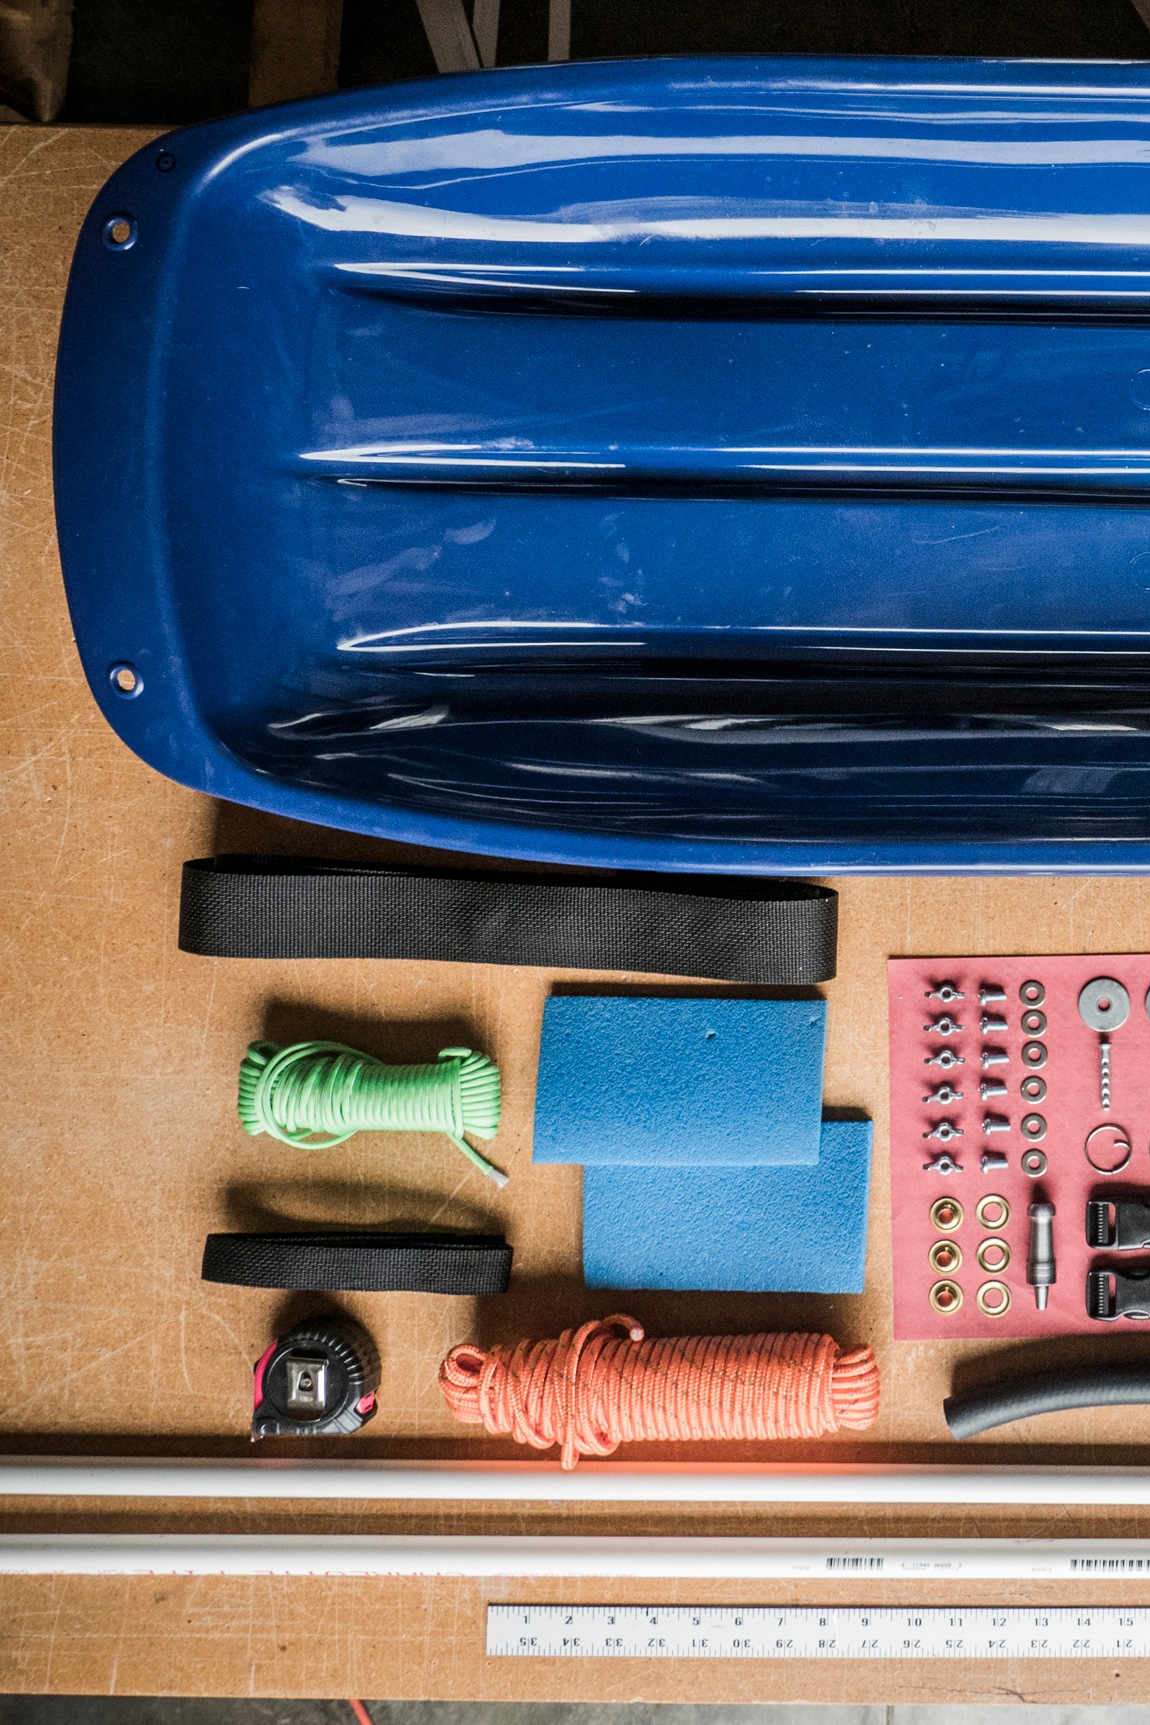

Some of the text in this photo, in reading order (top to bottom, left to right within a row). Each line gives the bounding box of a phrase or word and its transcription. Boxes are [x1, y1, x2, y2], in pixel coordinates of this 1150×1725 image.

[907, 1618, 922, 1626] 10
[949, 1618, 963, 1626] 11
[992, 1618, 1006, 1626] 12
[1035, 1618, 1048, 1626] 13
[1077, 1618, 1091, 1626] 14
[1119, 1618, 1133, 1626] 15
[520, 1637, 537, 1646] 35
[563, 1638, 580, 1646] 34
[605, 1638, 623, 1646] 33
[648, 1638, 665, 1647] 32
[692, 1639, 708, 1647] 31
[733, 1639, 751, 1647] 30
[776, 1639, 793, 1648] 29
[818, 1639, 836, 1648] 28
[861, 1640, 878, 1648] 27
[903, 1640, 920, 1648] 26
[946, 1640, 963, 1648] 25
[988, 1640, 1005, 1648] 24
[1031, 1640, 1048, 1648] 23
[1073, 1639, 1090, 1648] 22
[1116, 1639, 1133, 1648] 21
